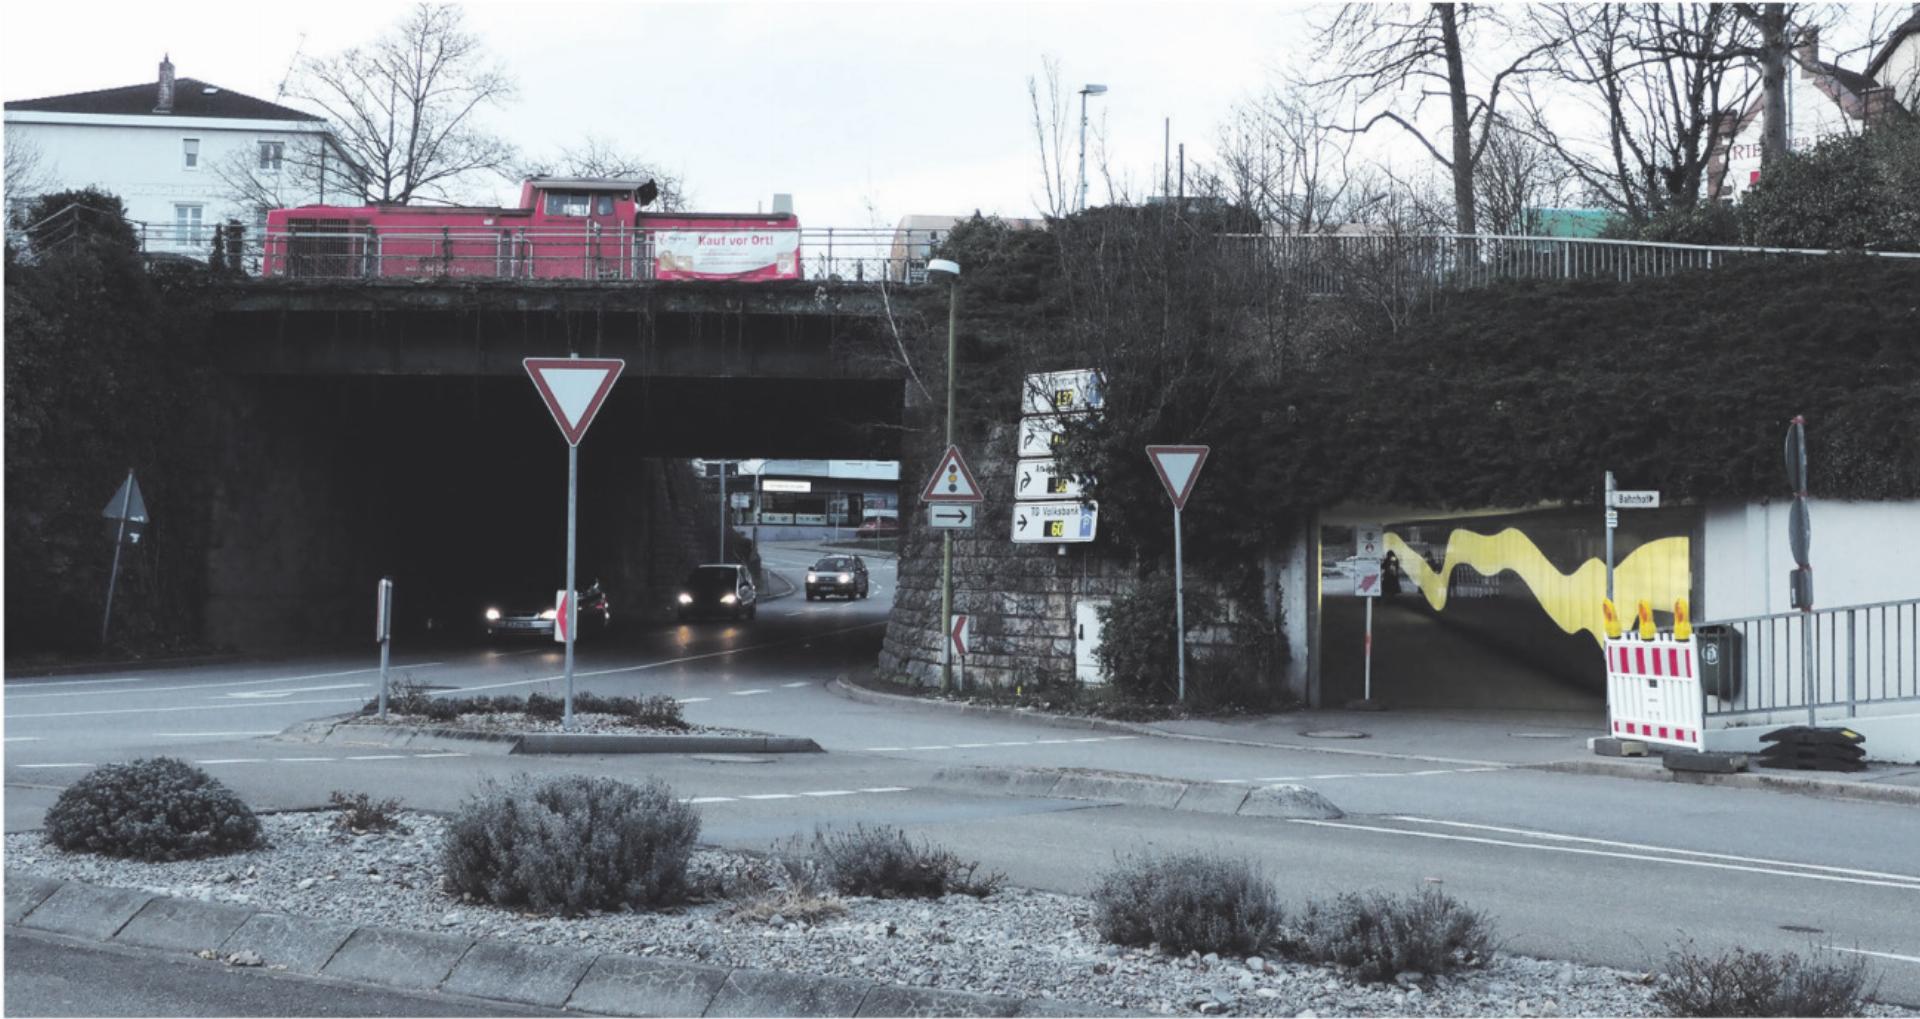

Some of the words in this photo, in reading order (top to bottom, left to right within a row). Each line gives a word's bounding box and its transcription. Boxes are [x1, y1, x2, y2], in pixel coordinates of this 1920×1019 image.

[698, 235, 727, 246] Kauf
[729, 237, 748, 246] vor
[751, 235, 774, 245] Ort!
[1619, 494, 1649, 504] Bahnhof
[1043, 505, 1079, 516] Volksbank
[1051, 520, 1063, 537] 60
